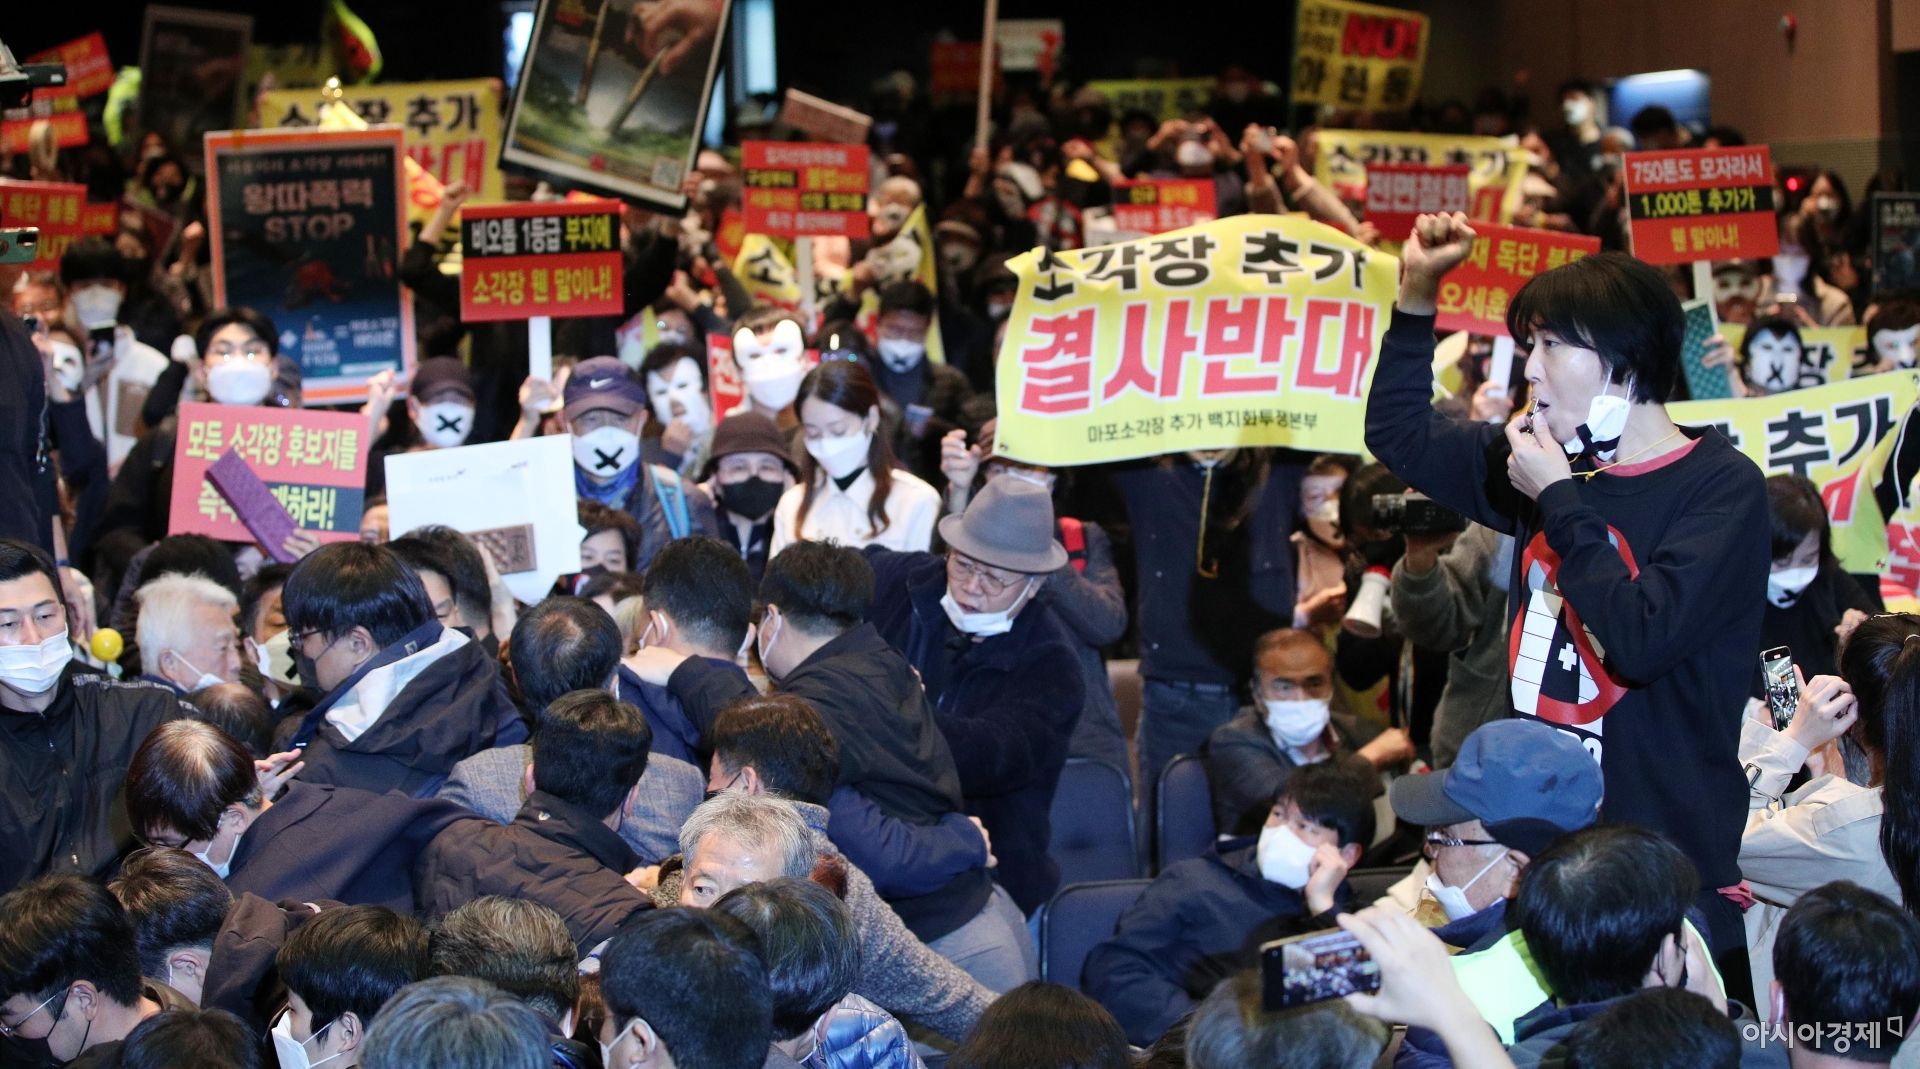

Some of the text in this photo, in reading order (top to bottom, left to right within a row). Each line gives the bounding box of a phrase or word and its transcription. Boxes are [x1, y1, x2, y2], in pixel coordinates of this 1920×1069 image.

[406, 94, 481, 135] 추가
[1631, 153, 1764, 185] 750톤도 모자라서
[244, 178, 374, 214] 왕따폭력
[1366, 171, 1468, 214] 전면철회
[1641, 186, 1756, 218] 1,000톤 추가가
[264, 211, 355, 243] STOP
[522, 216, 562, 254] 1등급
[566, 213, 612, 252] 부지에
[1033, 231, 1368, 302] 소각장 추가
[1496, 239, 1540, 277] 독단
[473, 268, 525, 305] 소각장
[1021, 296, 1376, 414] 결사반대
[1087, 408, 1318, 443] 마포소각장 추가 백지화투쟁본부
[1767, 397, 1898, 480] 추가
[185, 420, 359, 471] 모든 소각장 후보지를
